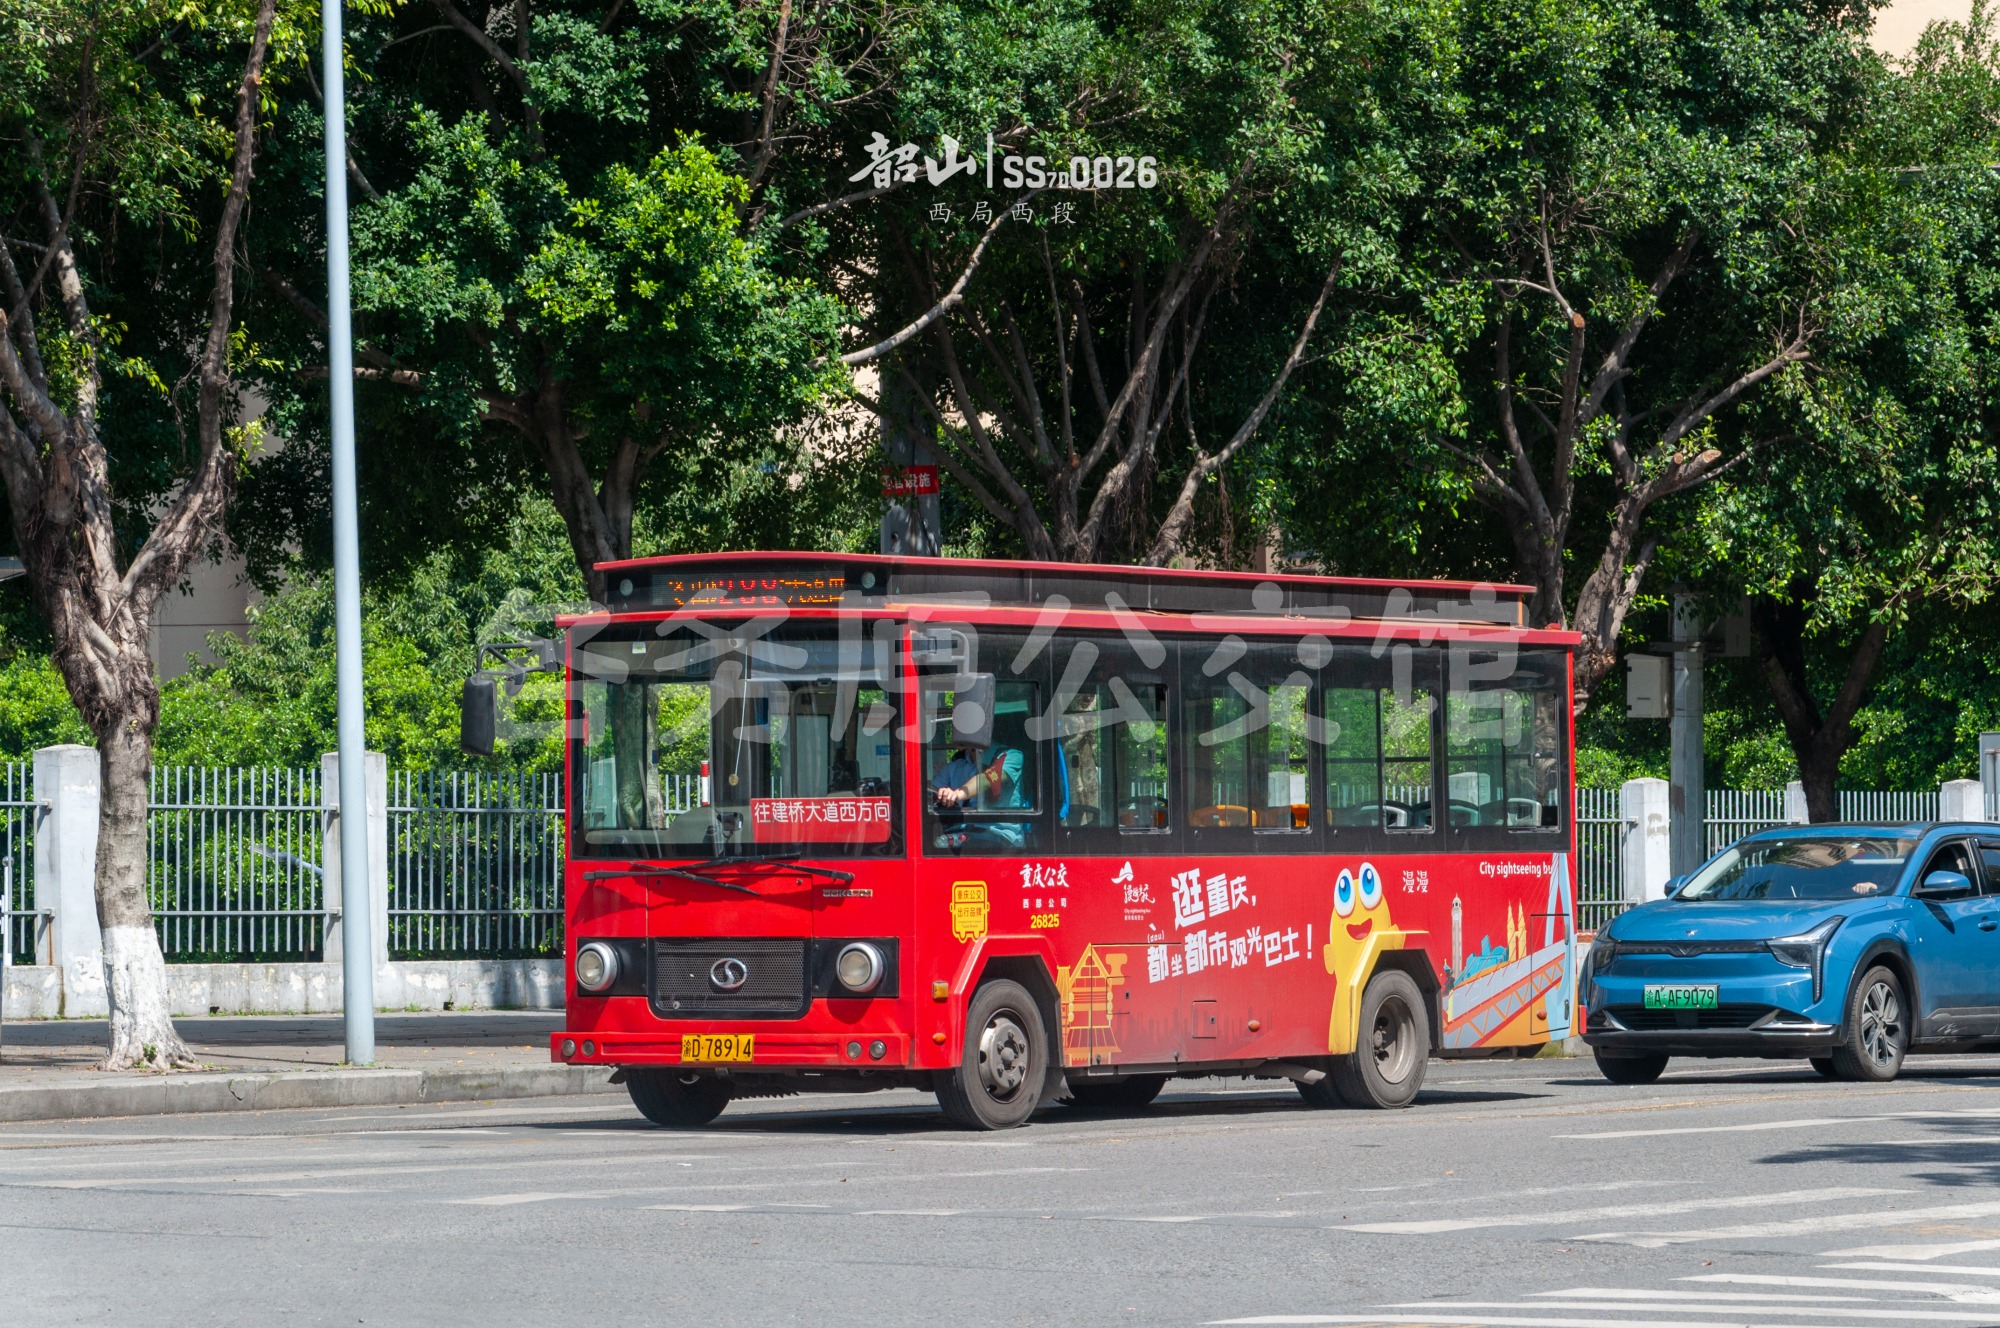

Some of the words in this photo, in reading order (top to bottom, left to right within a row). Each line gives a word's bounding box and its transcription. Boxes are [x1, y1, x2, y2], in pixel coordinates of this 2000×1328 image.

[754, 801, 891, 823] 往建桥大道西方向
[1019, 863, 1070, 888] 重庆公交
[1479, 862, 1495, 877] City
[1496, 862, 1542, 878] sightseeing
[1543, 863, 1552, 875] bu
[1402, 870, 1429, 893] 漫漫
[957, 889, 982, 900] 重庆公交
[1022, 898, 1067, 908] 西部公司
[957, 906, 982, 917] 出行品牌
[1030, 914, 1060, 928] 26825
